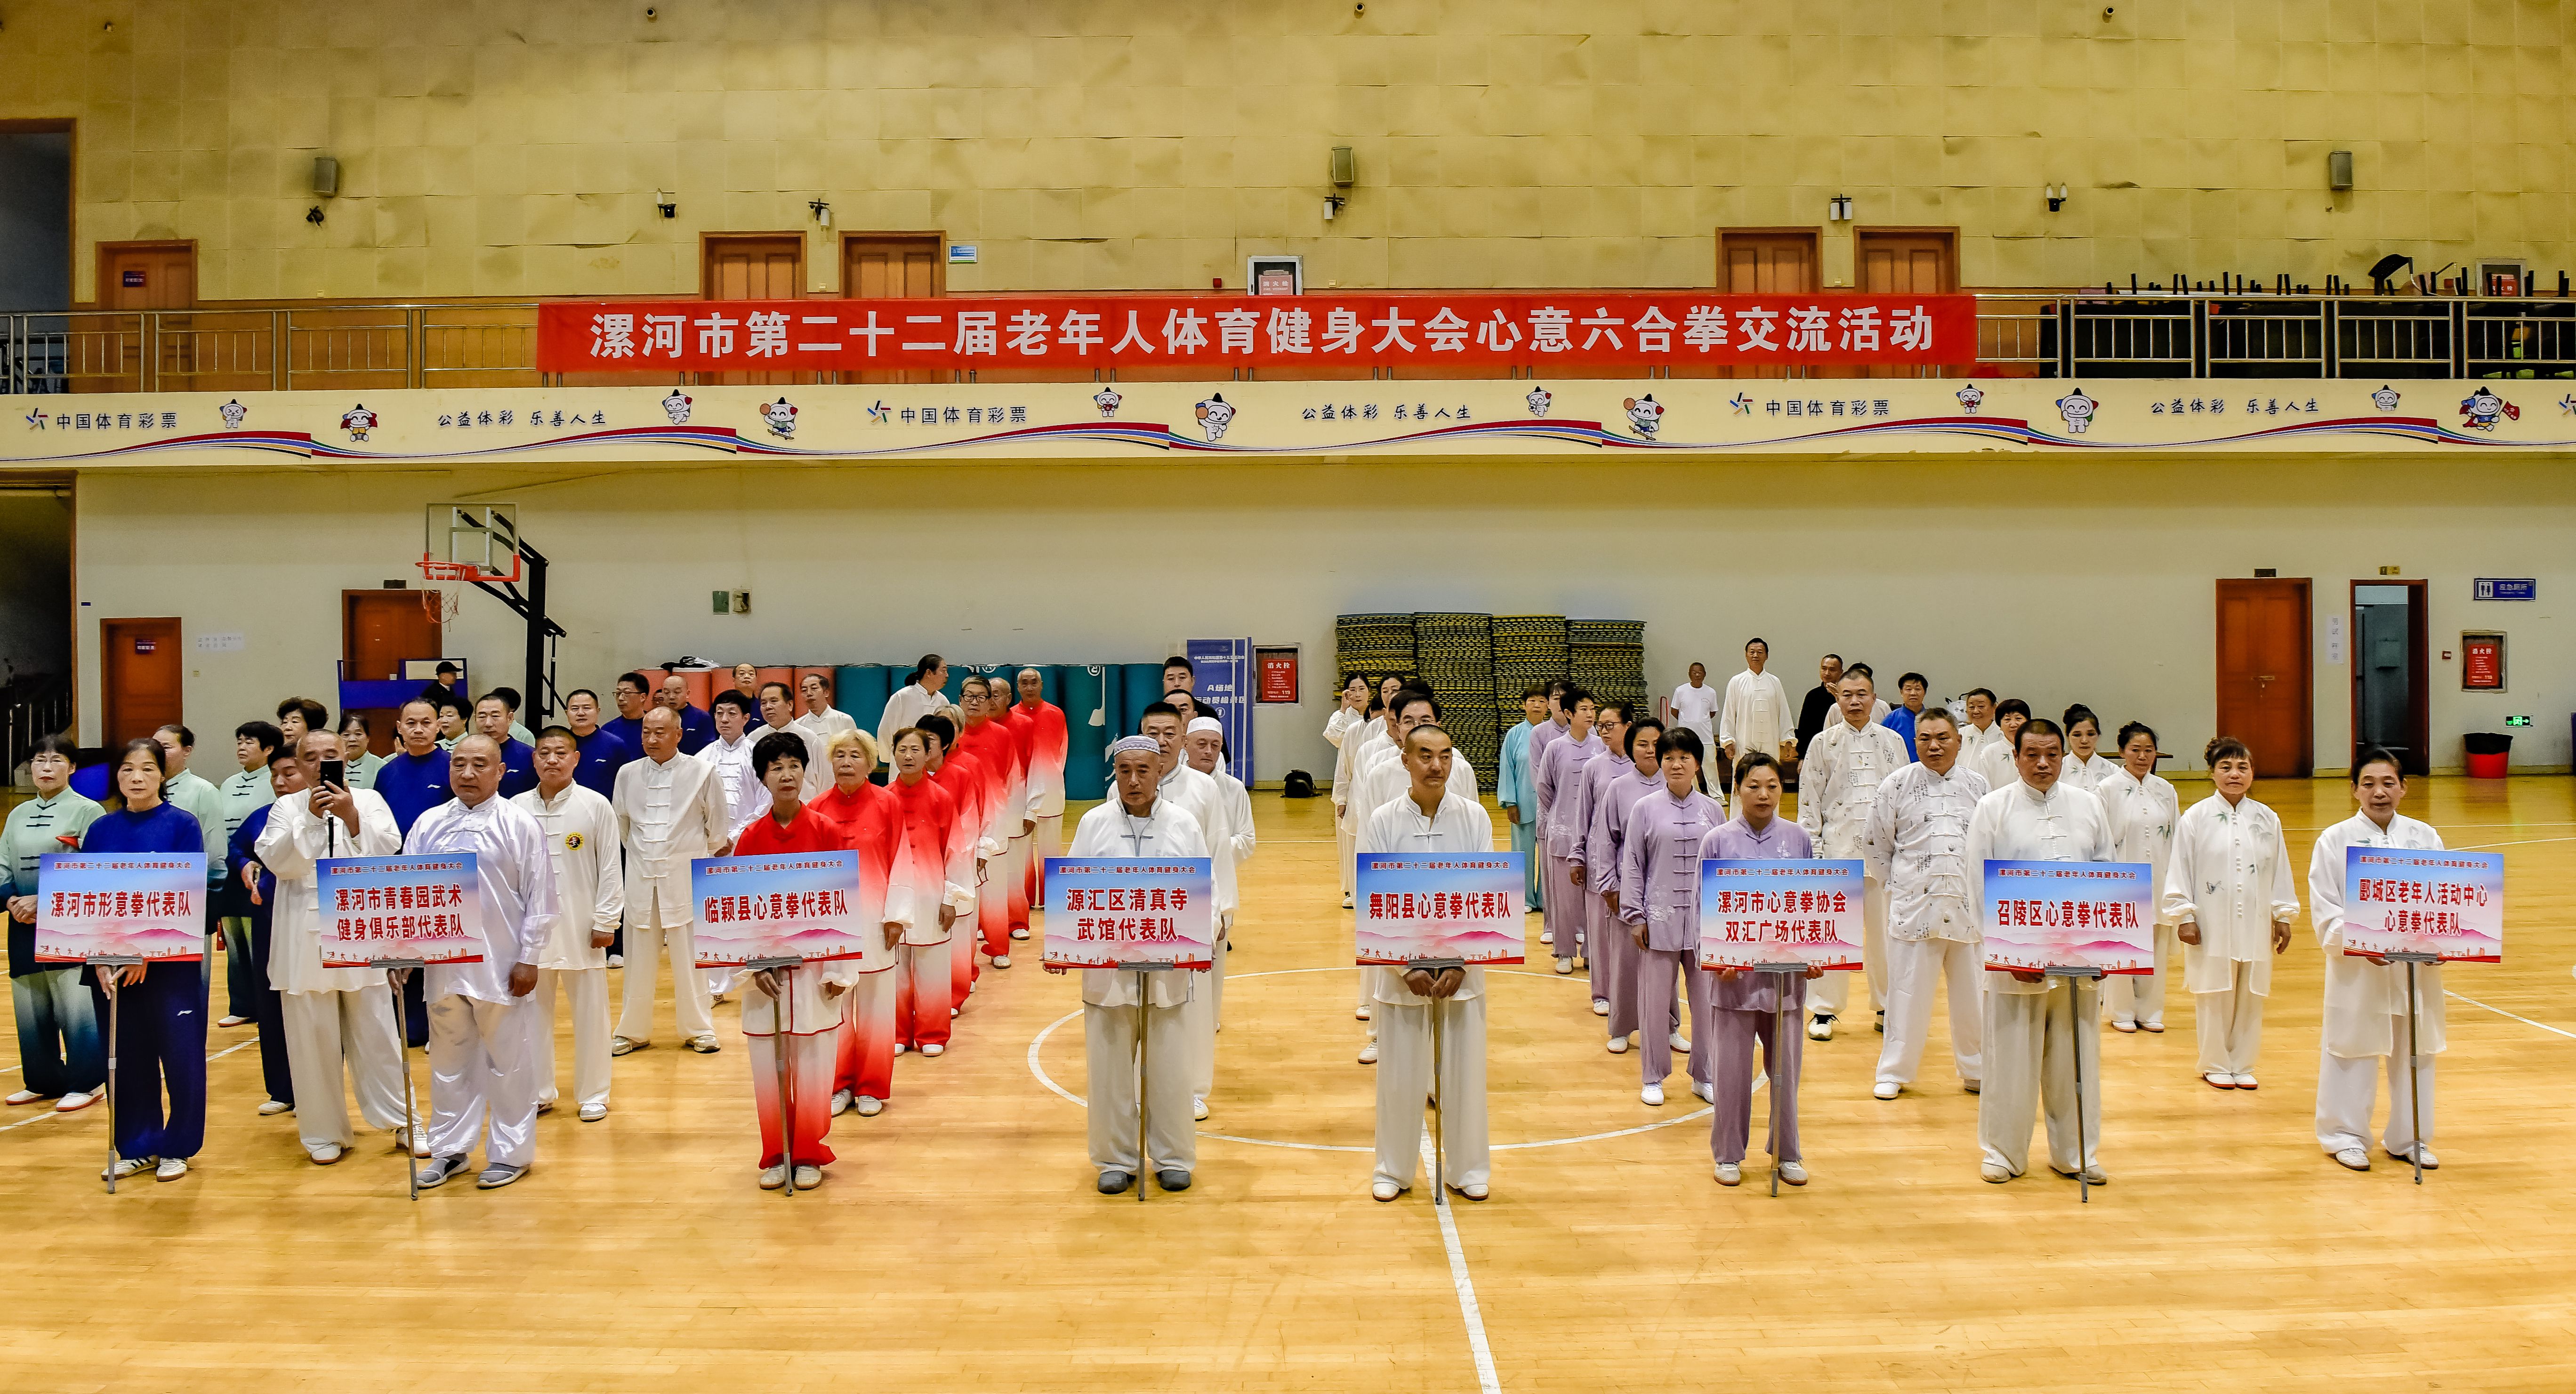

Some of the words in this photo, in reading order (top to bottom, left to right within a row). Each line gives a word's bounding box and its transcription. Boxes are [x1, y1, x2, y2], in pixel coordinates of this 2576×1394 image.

[590, 305, 1932, 358] 漯河市第二十二届老年人体育健身大会心意六合拳交流活动
[900, 406, 1027, 424] 中国体育彩票
[1302, 403, 1379, 420] 公益体彩
[1393, 403, 1472, 420] 乐善人生
[1765, 399, 1890, 417] 中国体育彩票
[2150, 398, 2225, 414] 公益体彩
[2246, 397, 2319, 415] 乐善人生
[56, 412, 177, 430] 中国体育彩票
[437, 410, 514, 427] 公益体彩
[530, 410, 606, 427] 乐善人生
[51, 891, 191, 918] 漯河市形意拳代表队
[336, 884, 463, 912] 漯河市青春园武术
[1067, 888, 1188, 912] 源汇区清真寺
[1718, 890, 1846, 914] 漯河市心意拳协会
[2359, 878, 2488, 907] 郾城区老年人活动中心
[1369, 892, 1511, 919] 舞阳县心意拳代表队
[1997, 900, 2139, 929] 召陵区心意拳代表队
[337, 913, 464, 941] 健身俱乐部代表队
[1077, 917, 1178, 941] 武馆代表队
[1725, 919, 1838, 943] 双汇广场代表队
[2384, 909, 2461, 936] 心意拳代表队
